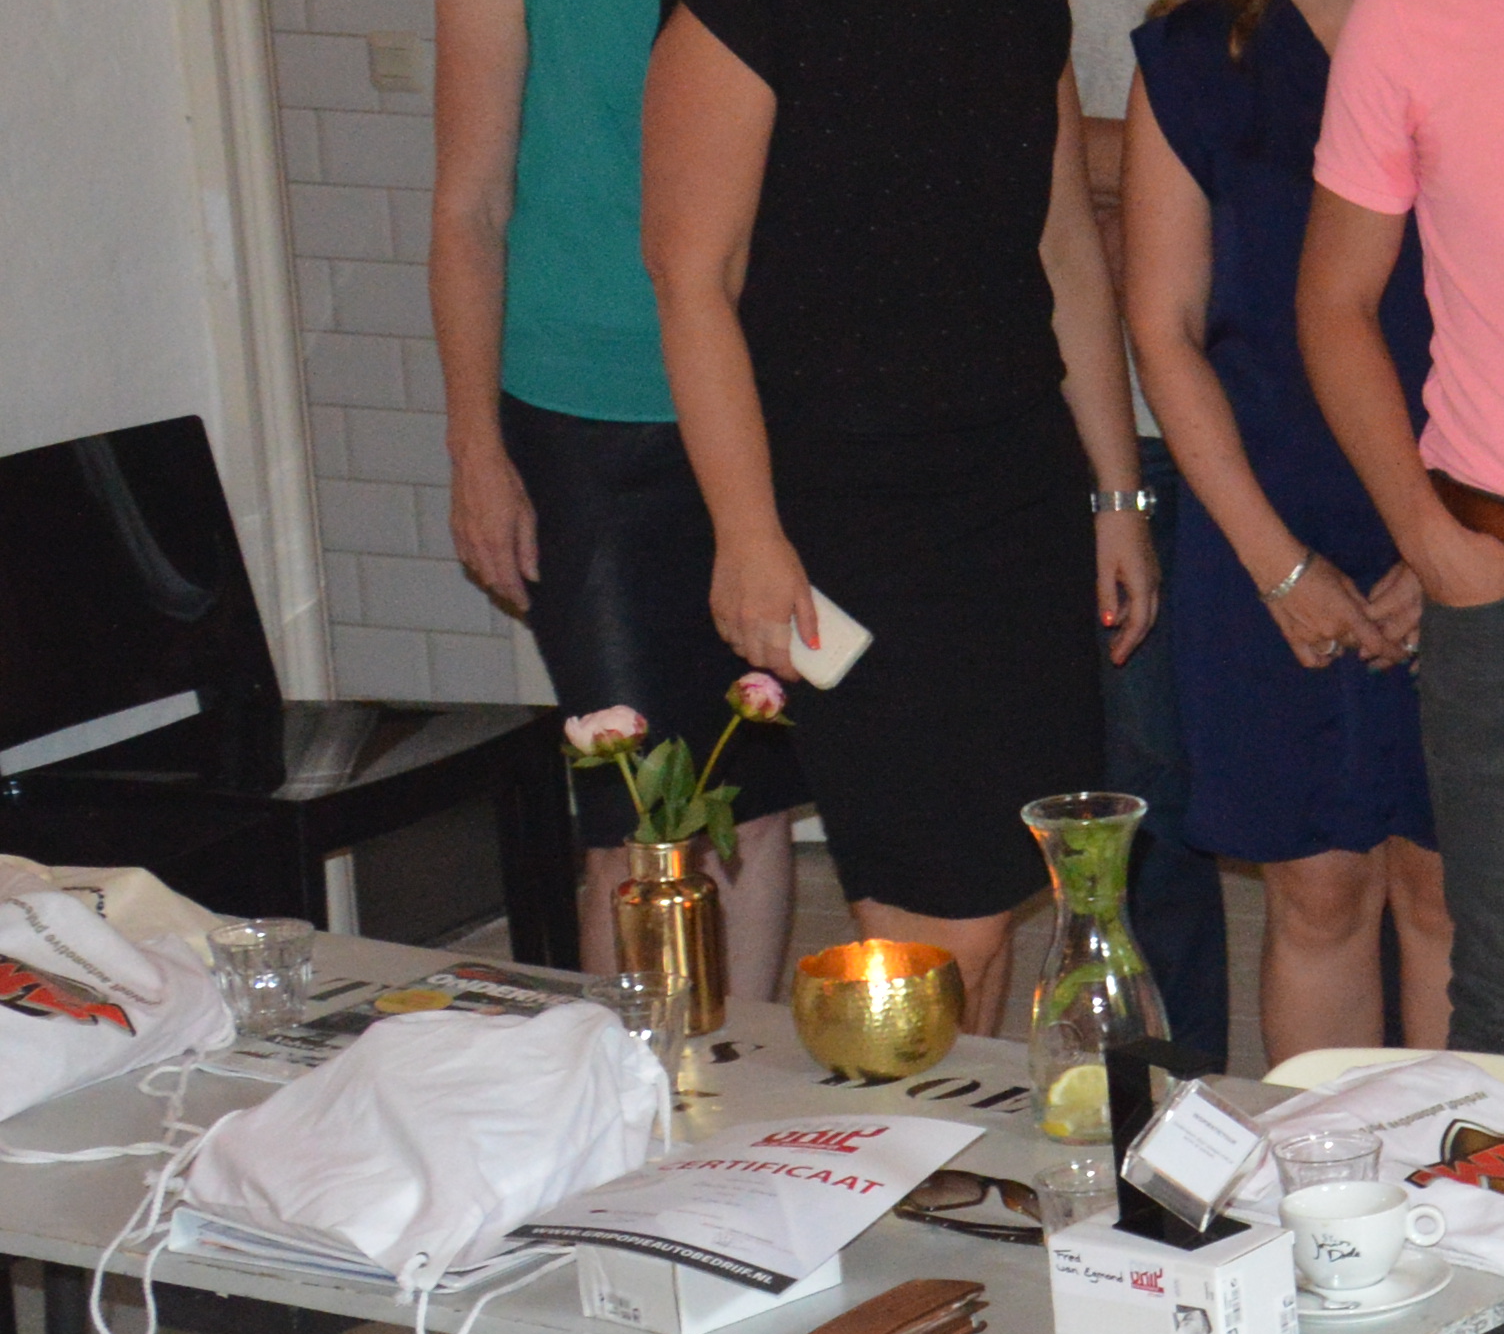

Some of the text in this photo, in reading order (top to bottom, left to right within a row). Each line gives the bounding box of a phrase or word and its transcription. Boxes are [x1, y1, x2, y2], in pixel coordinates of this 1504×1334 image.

[657, 1158, 885, 1195] CERTIFICAAT
[531, 1226, 774, 1285] WWW.GRIPOPJEAUTOBEDRIJF.NL
[1083, 1267, 1125, 1284] Egmond
